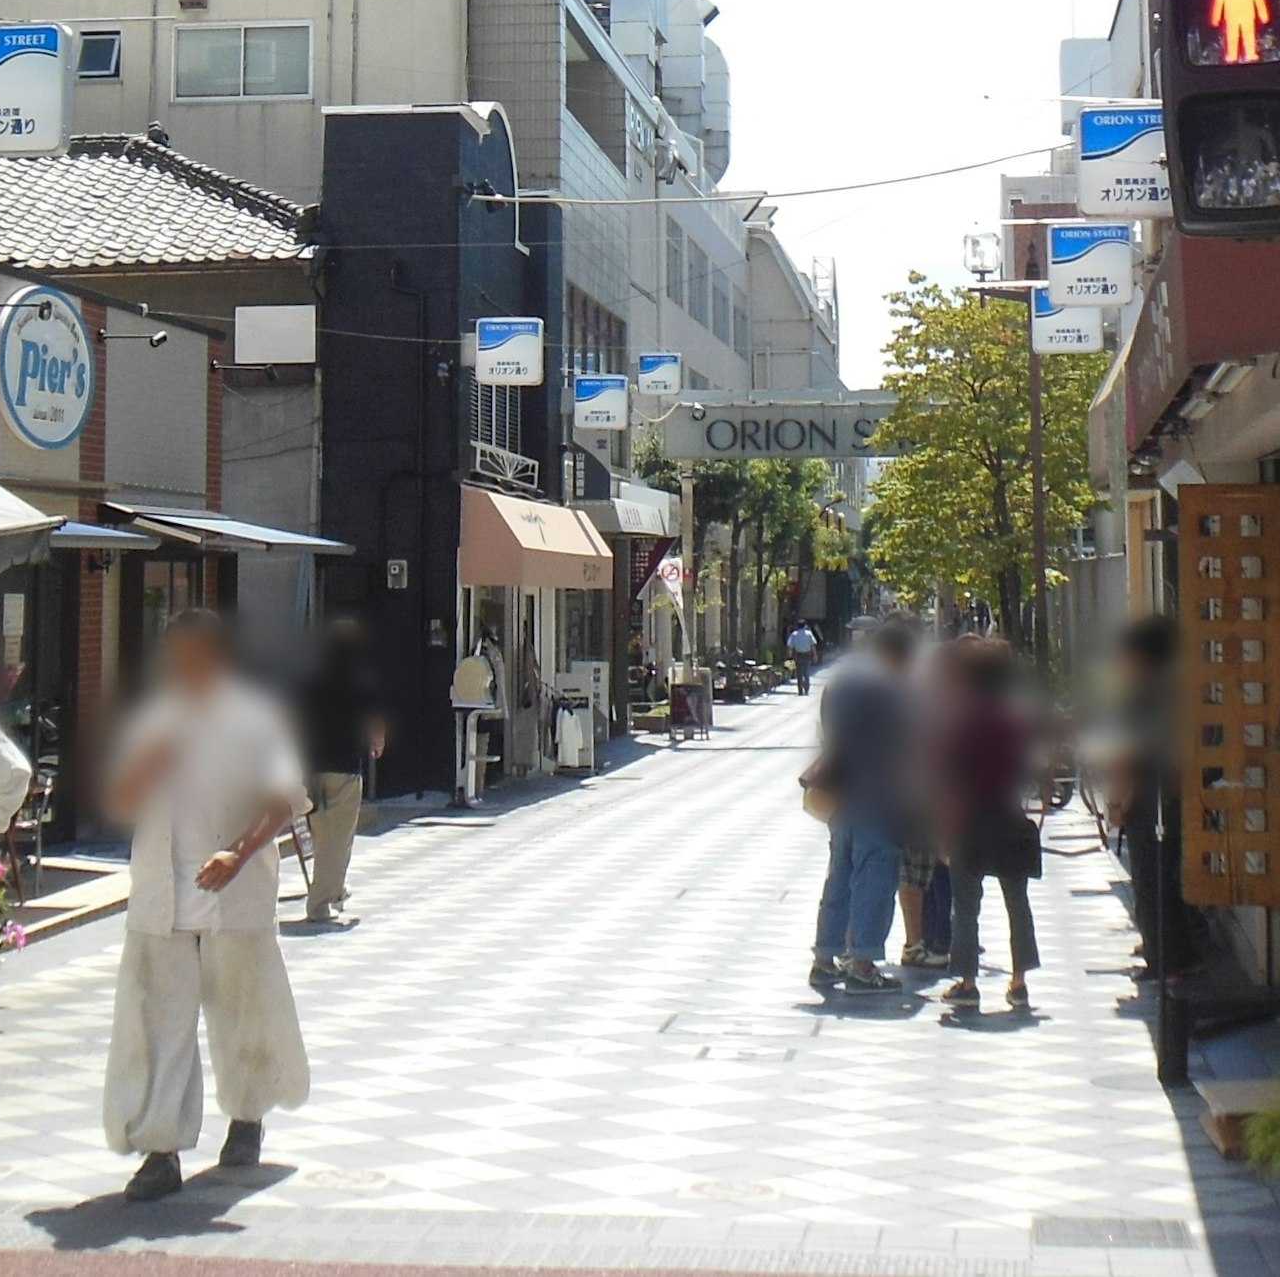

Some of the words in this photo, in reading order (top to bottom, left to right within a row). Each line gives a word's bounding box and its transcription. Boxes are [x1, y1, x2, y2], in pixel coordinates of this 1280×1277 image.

[4, 34, 46, 46] STREET
[1093, 114, 1134, 126] ORION
[1137, 114, 1163, 125] STRE
[1100, 187, 1170, 202] オリオン通り
[1060, 229, 1090, 239] ORION
[1066, 283, 1118, 295] オリオン通り
[15, 339, 86, 406] Pier's
[705, 419, 836, 451] ORION
